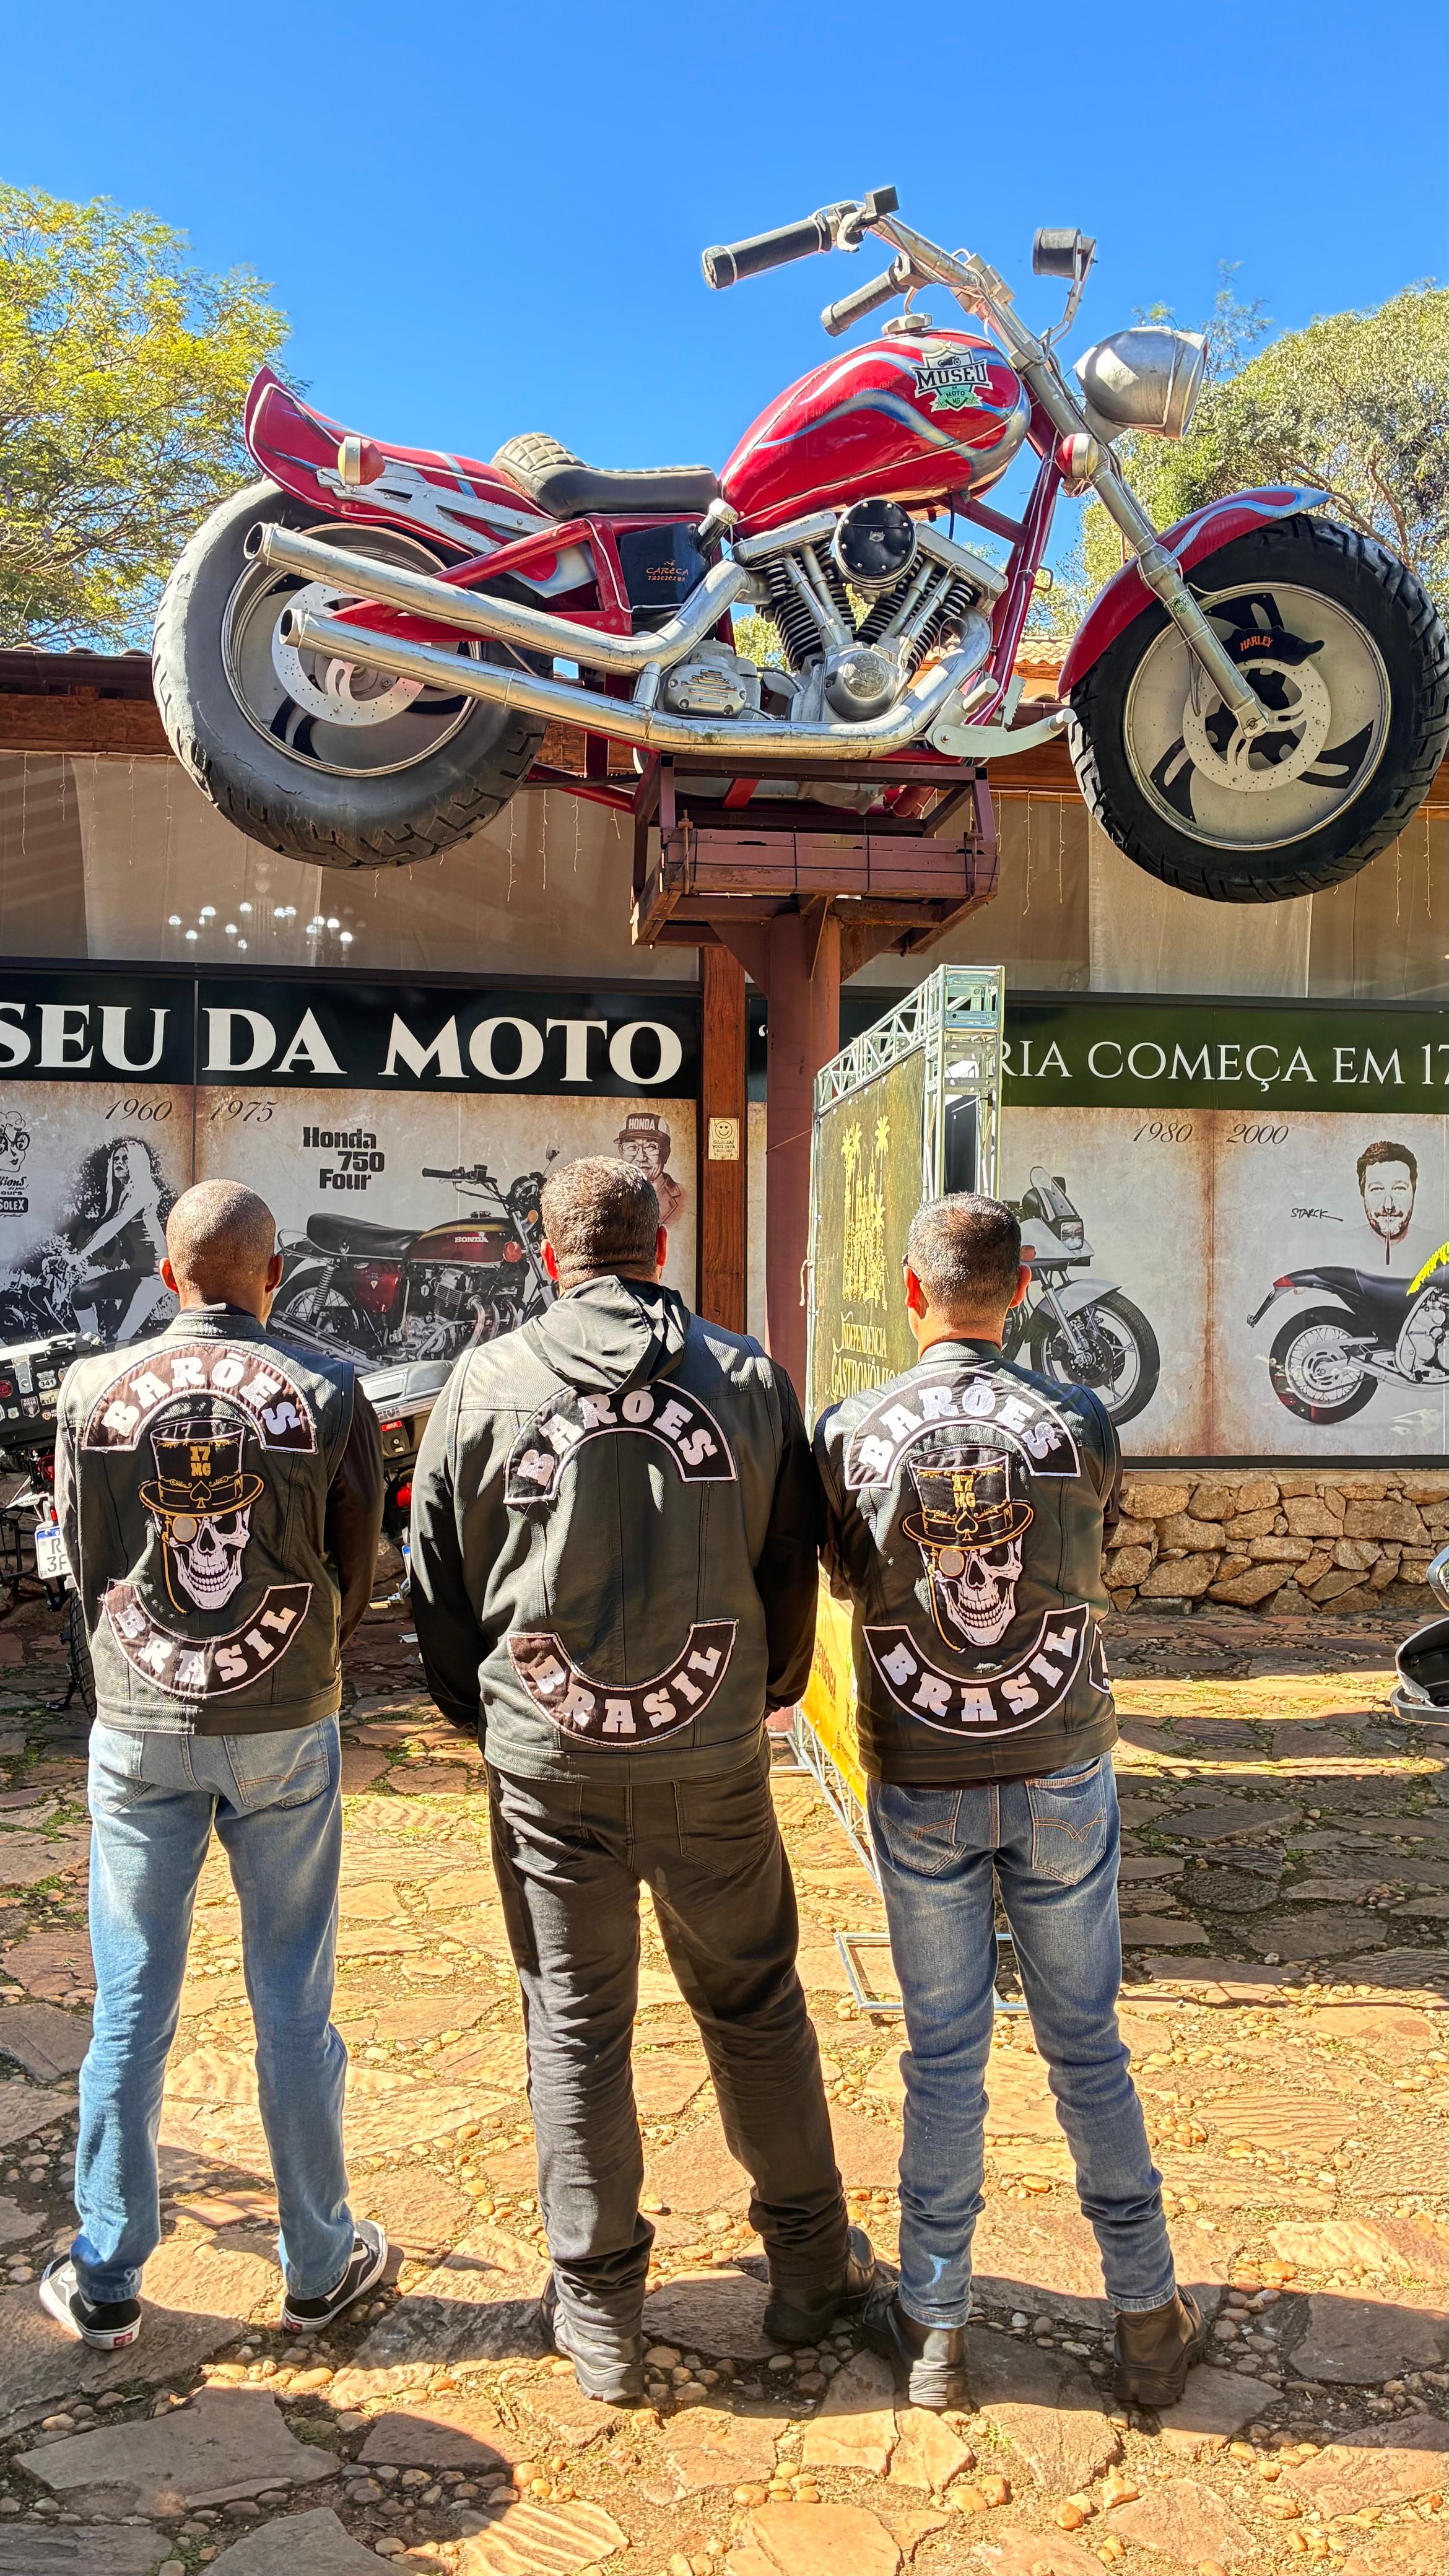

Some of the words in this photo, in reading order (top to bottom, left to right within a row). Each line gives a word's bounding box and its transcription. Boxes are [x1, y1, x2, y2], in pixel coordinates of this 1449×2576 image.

[915, 363, 987, 389] MUSEU
[1240, 635, 1274, 652] HARLEY
[0, 1001, 171, 1071] SEU
[202, 1007, 347, 1075] DA
[377, 1012, 682, 1085] MOTO
[1088, 1041, 1318, 1092] COMEÇA
[1333, 1047, 1406, 1084] EM
[105, 1099, 173, 1121] 1960
[211, 1099, 278, 1122] 1975
[628, 1118, 655, 1131] HONDA
[1133, 1121, 1193, 1143] 1980
[1226, 1123, 1289, 1144] 2000
[303, 1126, 376, 1149] Honda
[337, 1151, 385, 1172] 750
[320, 1168, 372, 1190] Four
[1290, 1208, 1344, 1222] STARCK
[101, 1353, 302, 1437] BARÕES
[858, 1376, 1060, 1473] BARÕES
[189, 1446, 211, 1461] 17
[952, 1474, 974, 1492] 17
[117, 1603, 300, 1686] BRASIL
[879, 1625, 1077, 1722] BRASIL
[528, 1644, 723, 1733] BRASIL
